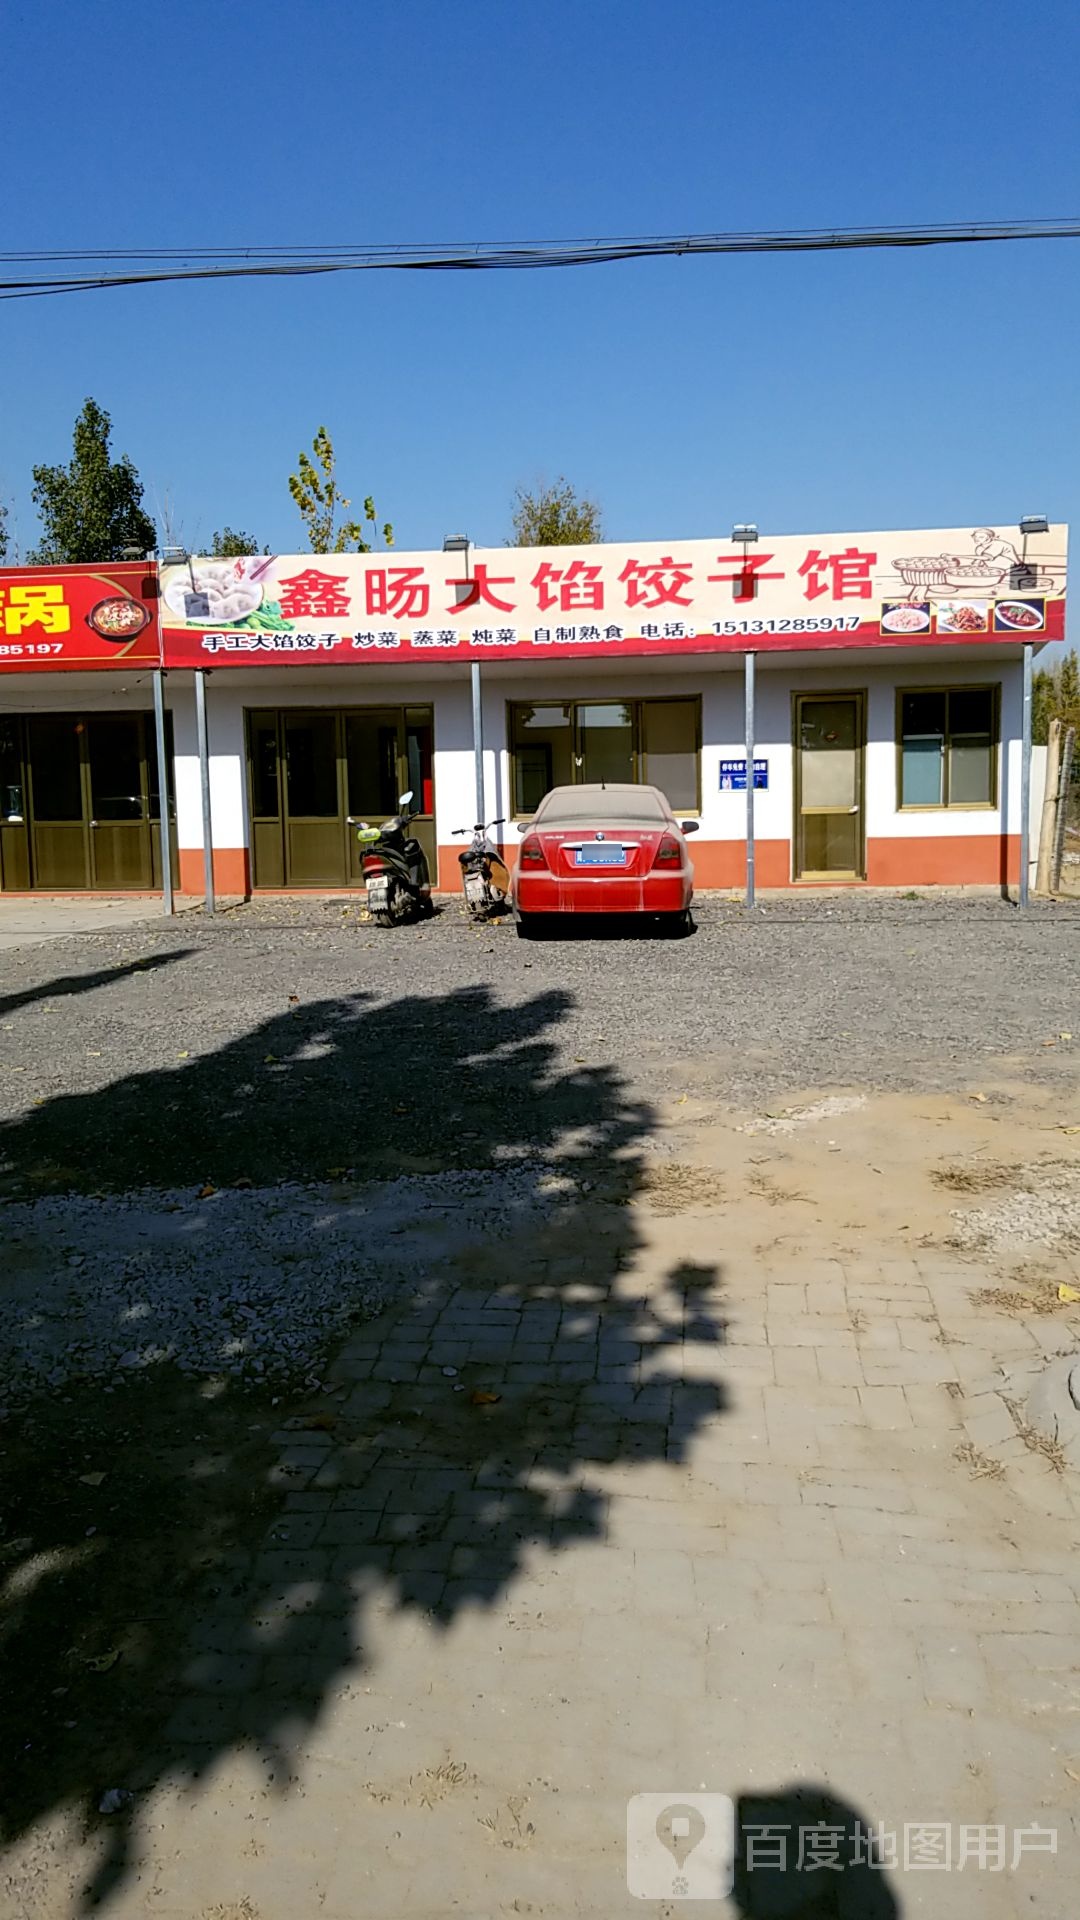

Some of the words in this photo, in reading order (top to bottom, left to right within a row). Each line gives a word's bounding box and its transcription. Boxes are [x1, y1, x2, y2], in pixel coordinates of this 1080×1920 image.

[277, 547, 878, 620] 鑫旸大馅饺子馆
[203, 632, 340, 651] 手工大馅饺子
[354, 631, 399, 647] 炒菜
[413, 630, 458, 646] 蒸菜
[471, 628, 517, 644] 炖菜
[533, 624, 624, 642] 自制熟食
[711, 616, 861, 635] 15131285917
